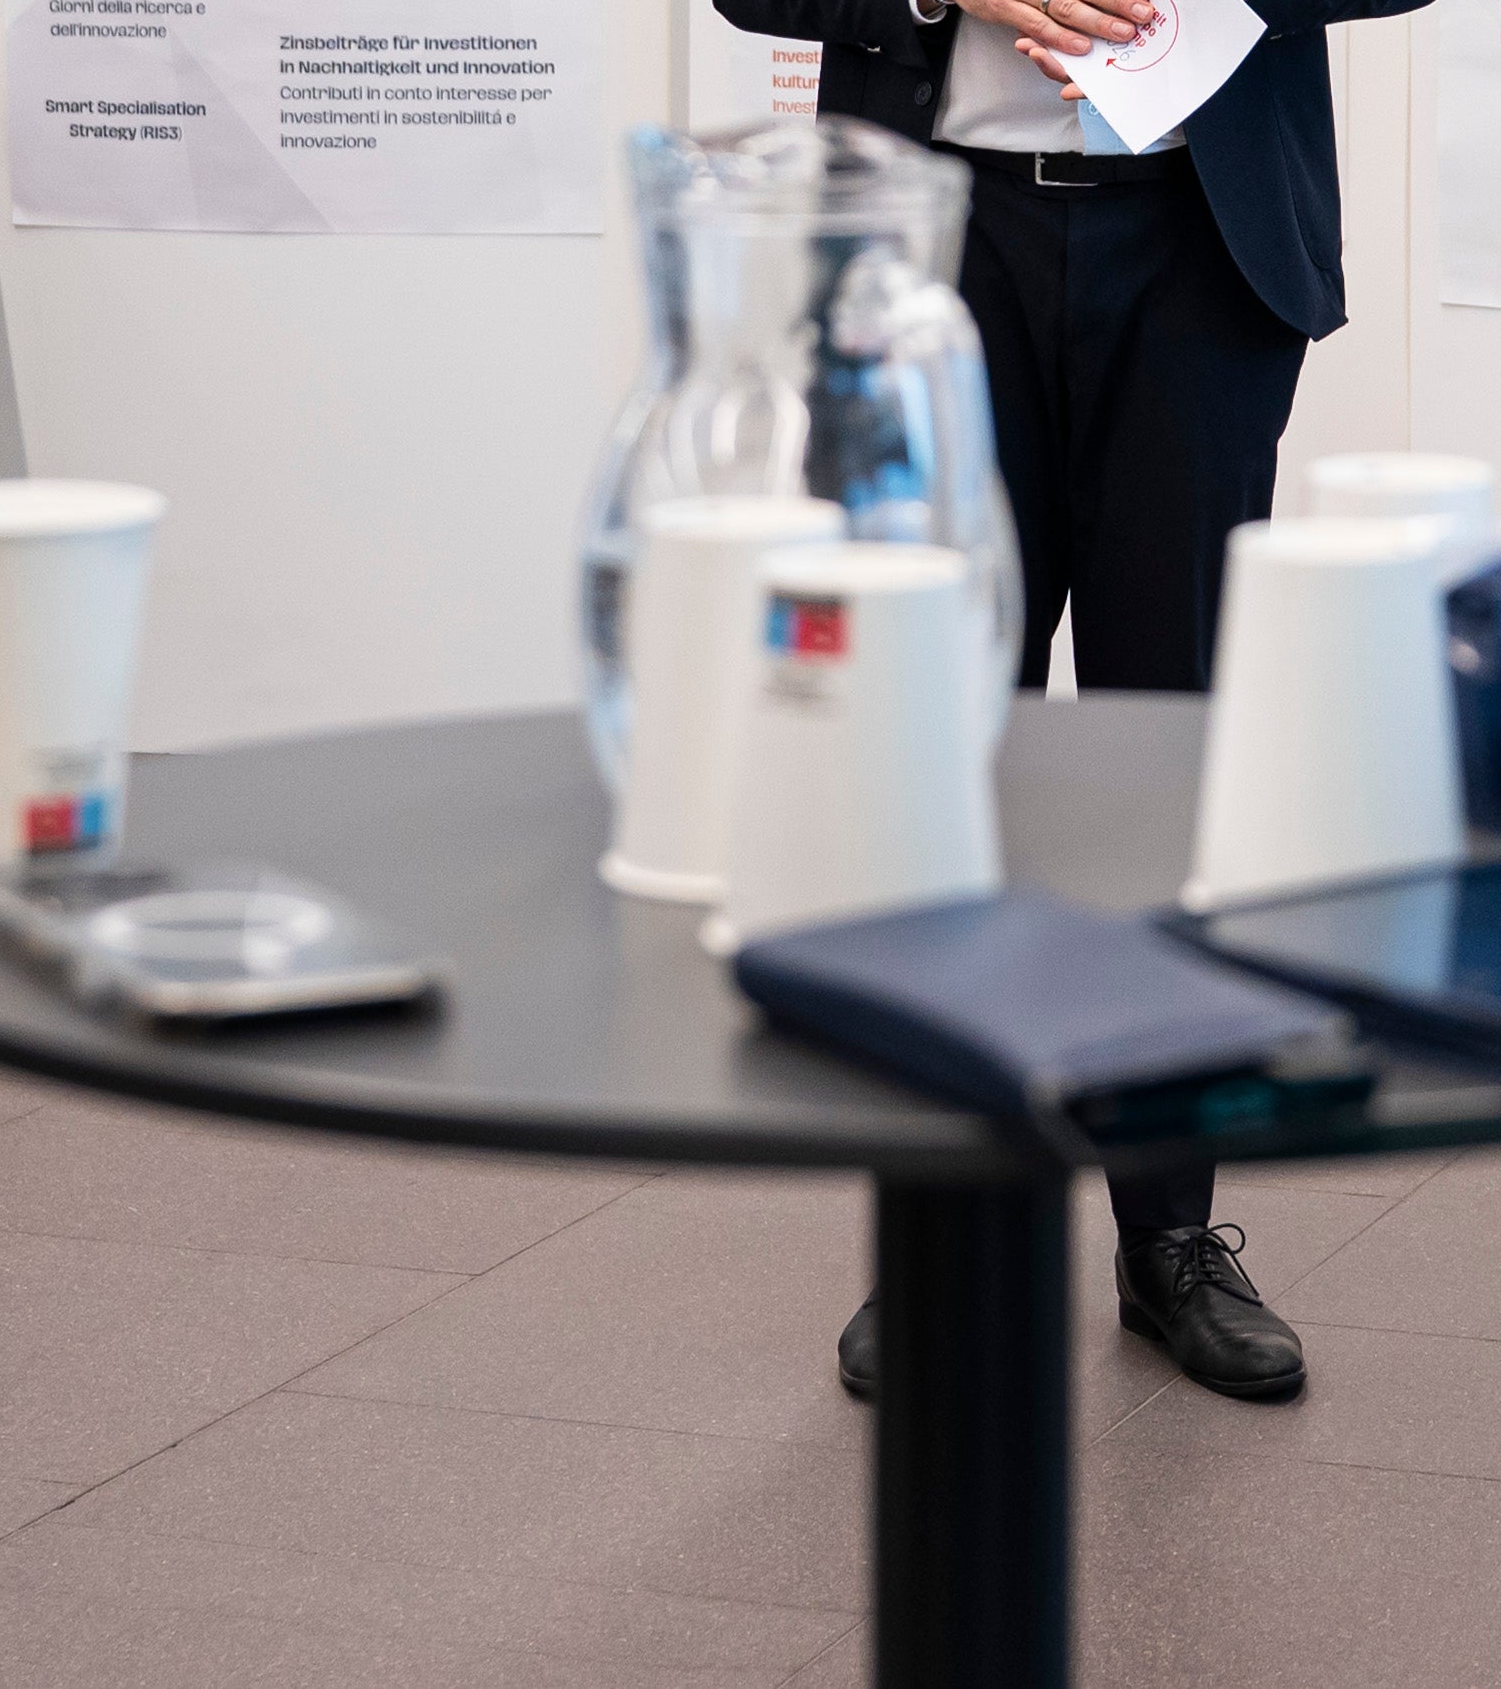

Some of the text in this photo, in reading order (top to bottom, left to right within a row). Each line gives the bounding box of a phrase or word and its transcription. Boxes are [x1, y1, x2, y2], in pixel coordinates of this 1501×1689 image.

[279, 34, 538, 53] Zinsbeiträge für Investitionen
[279, 59, 556, 77] in Nachhaltigkeit und Innovation
[279, 85, 553, 103] Contributi in conto interesse per
[45, 98, 207, 117] Smart Specialisation
[280, 108, 381, 125] investimenti
[383, 109, 398, 125] in
[505, 112, 517, 125] e
[69, 123, 183, 142] Strategy (RIS3)
[280, 133, 377, 149] innovazione
